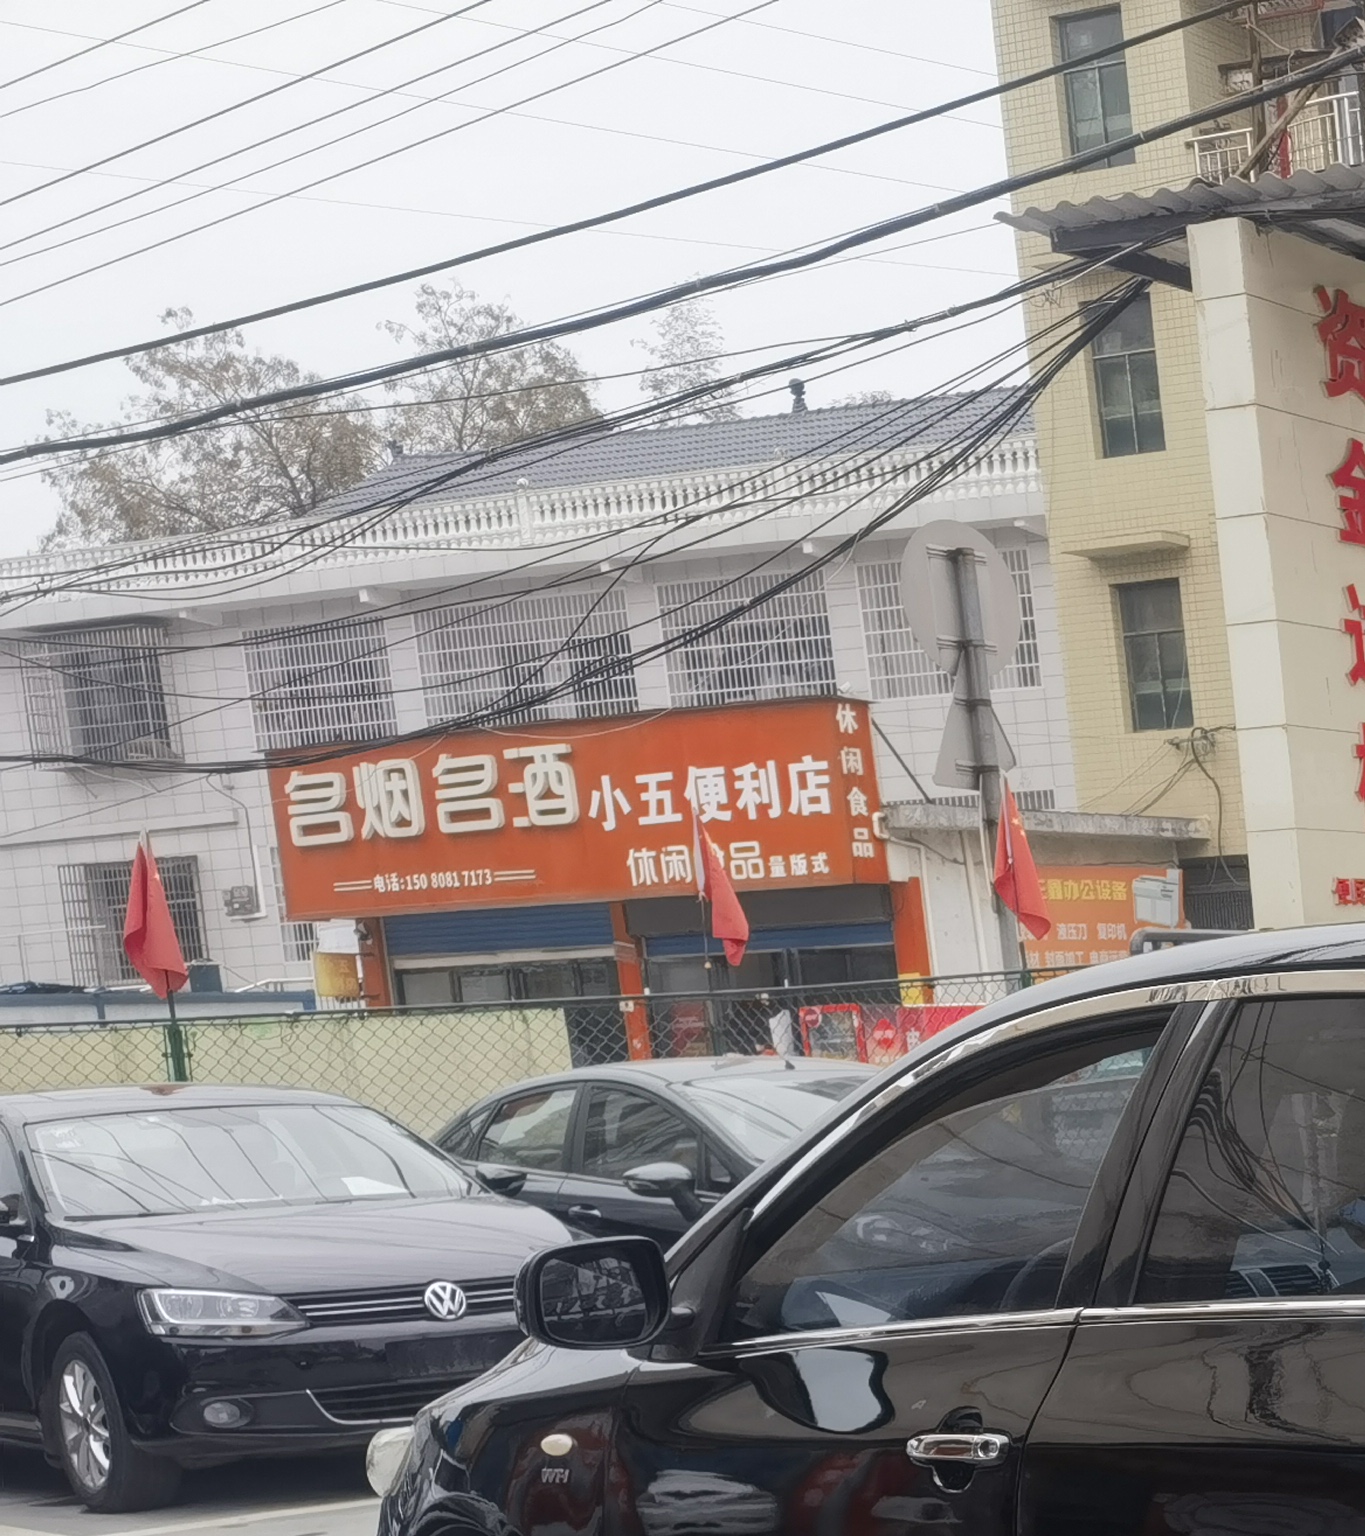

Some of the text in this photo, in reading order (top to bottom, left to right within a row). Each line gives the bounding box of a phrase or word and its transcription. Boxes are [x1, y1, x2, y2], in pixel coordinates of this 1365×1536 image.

[284, 743, 580, 847] 名烟名酒
[588, 755, 832, 832] 小五便利店
[835, 703, 875, 859] 休闲食品
[431, 870, 461, 889] 8081
[463, 868, 493, 887] 7173
